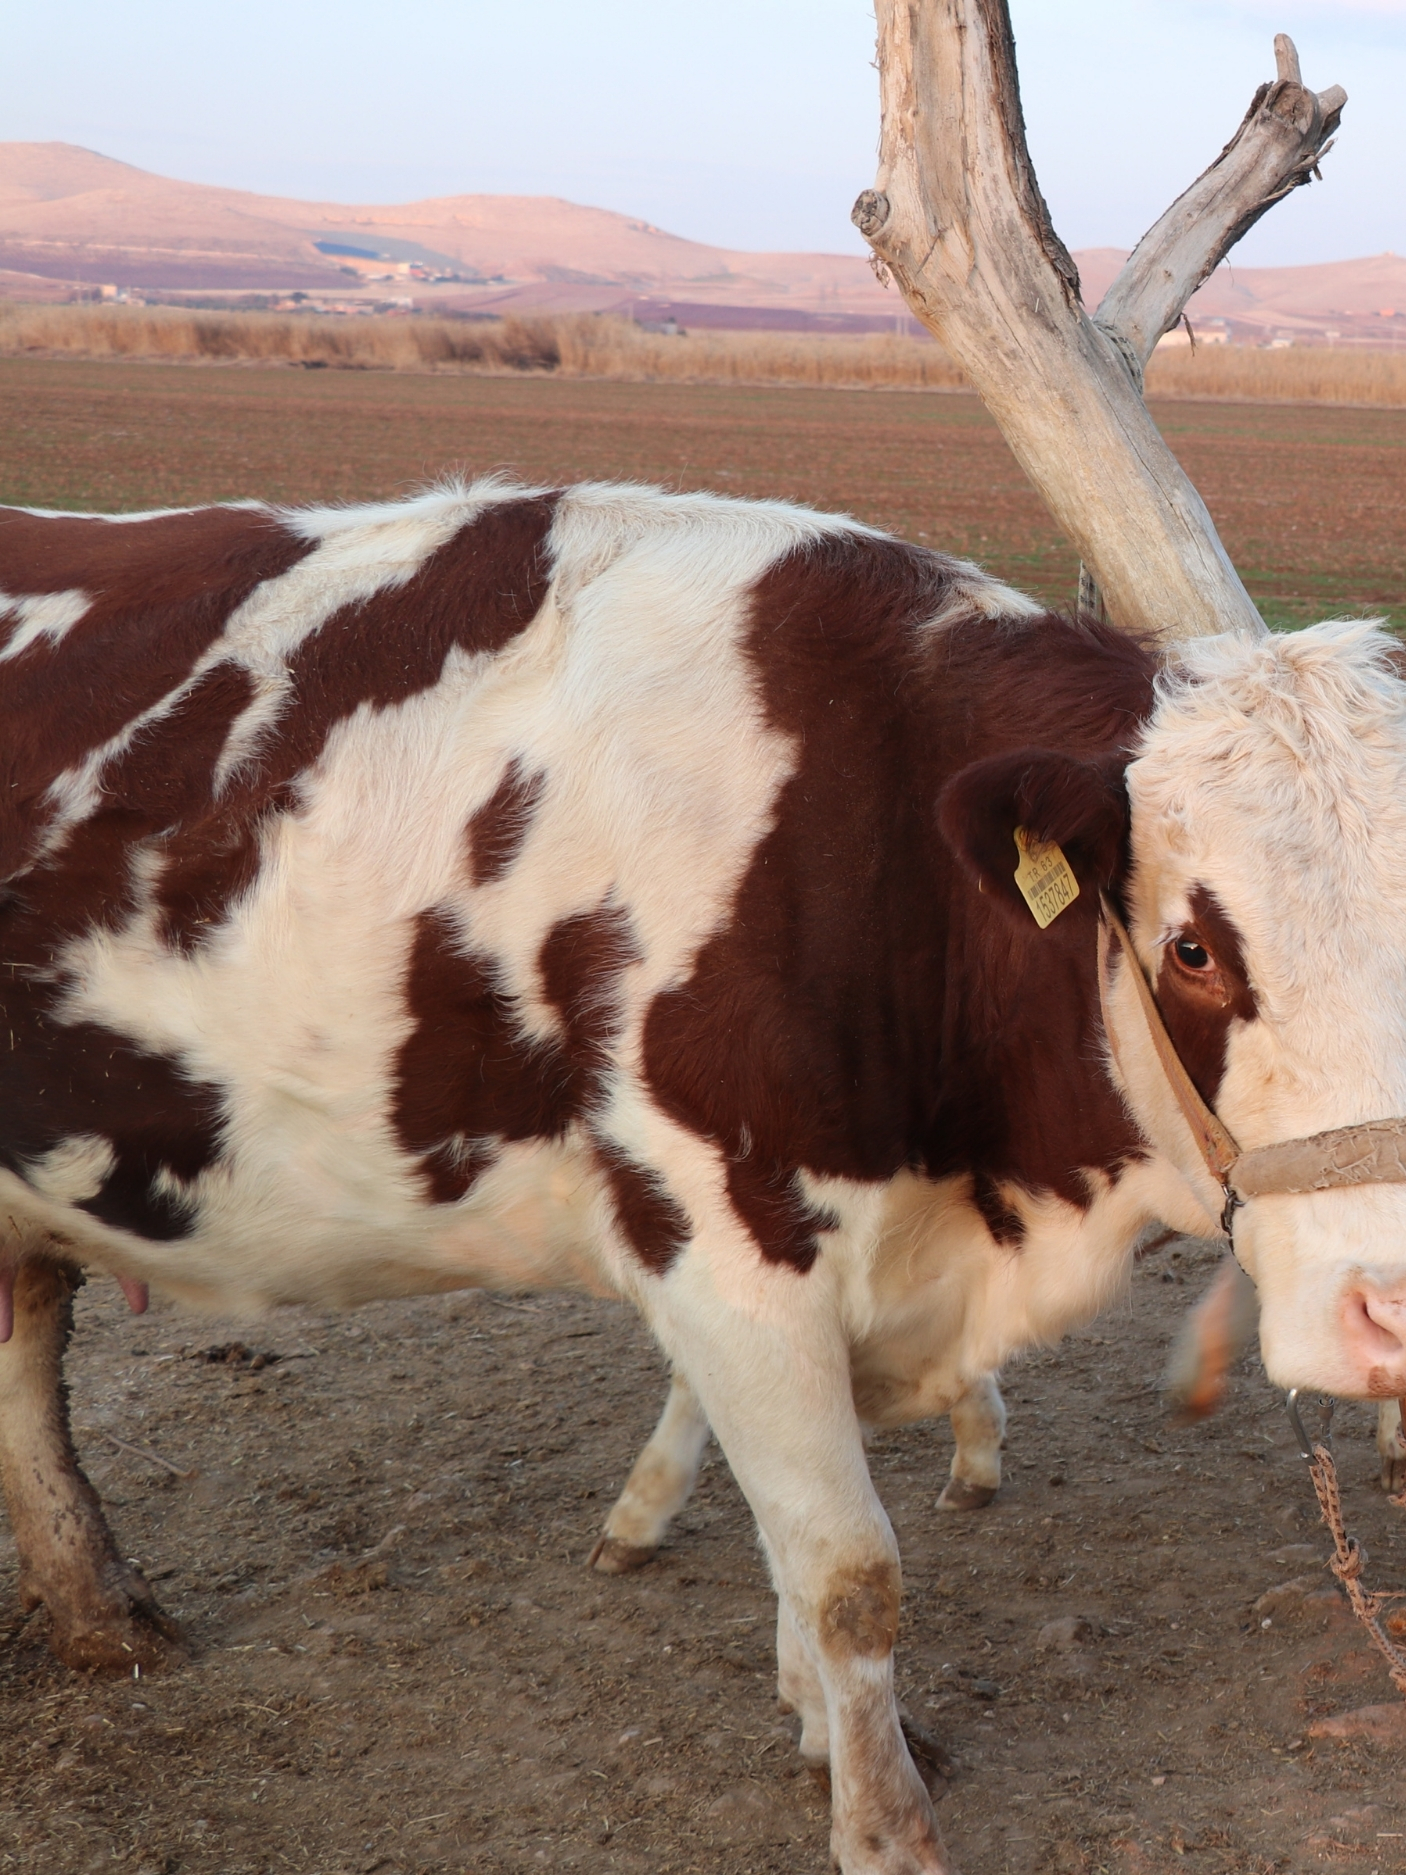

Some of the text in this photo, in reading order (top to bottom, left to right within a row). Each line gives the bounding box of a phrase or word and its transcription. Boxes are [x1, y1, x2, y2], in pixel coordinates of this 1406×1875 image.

[1027, 856, 1053, 882] TR 63
[1036, 874, 1074, 922] 1537847
